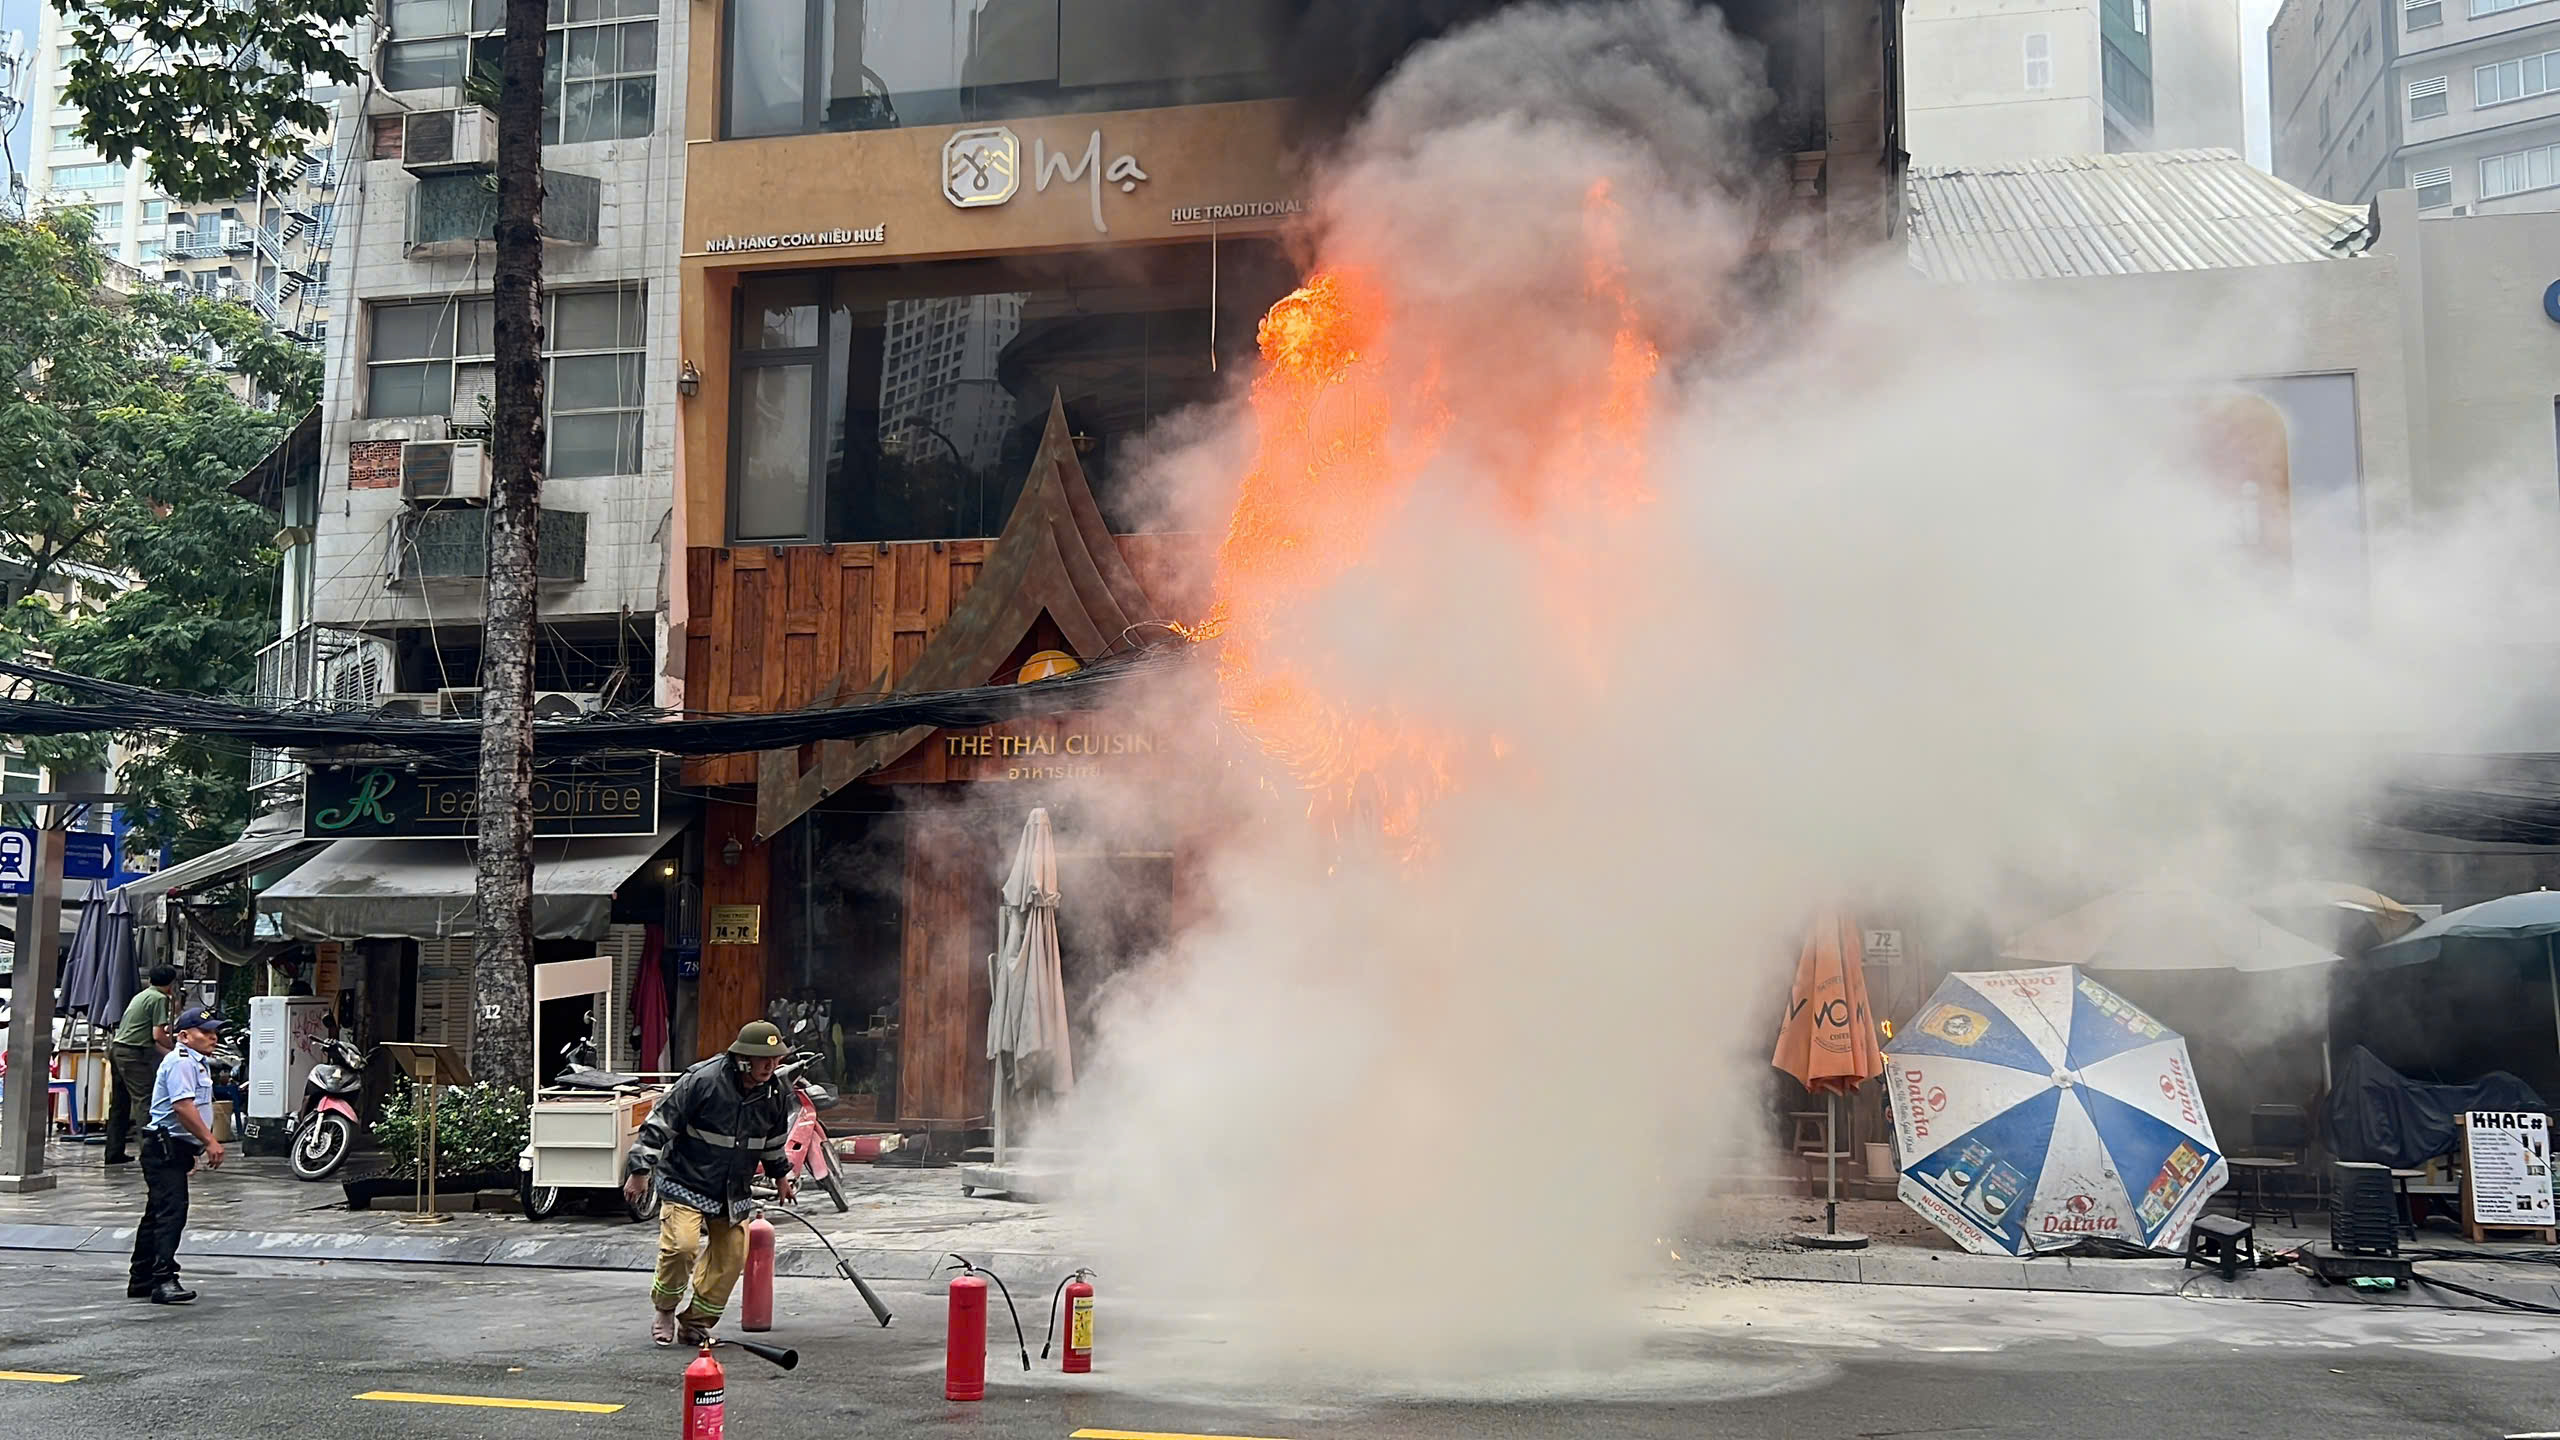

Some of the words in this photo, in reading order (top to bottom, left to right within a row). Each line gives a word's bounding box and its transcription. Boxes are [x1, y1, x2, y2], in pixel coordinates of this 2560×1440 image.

[1171, 207, 1201, 221] HUE
[1205, 200, 1303, 219] TRADITIONAL
[706, 234, 735, 252] NHÀ
[738, 234, 778, 250] HÀNG
[781, 232, 815, 247] CƠM
[854, 222, 886, 242] HUẾ
[946, 735, 993, 756] THE
[1000, 735, 1056, 756] THAI
[1065, 734, 1169, 755] CUISINE
[417, 783, 479, 815] Tea
[531, 780, 641, 813] Coffee
[1874, 932, 1892, 947] 72
[684, 960, 700, 973] 78
[485, 1004, 501, 1019] 12
